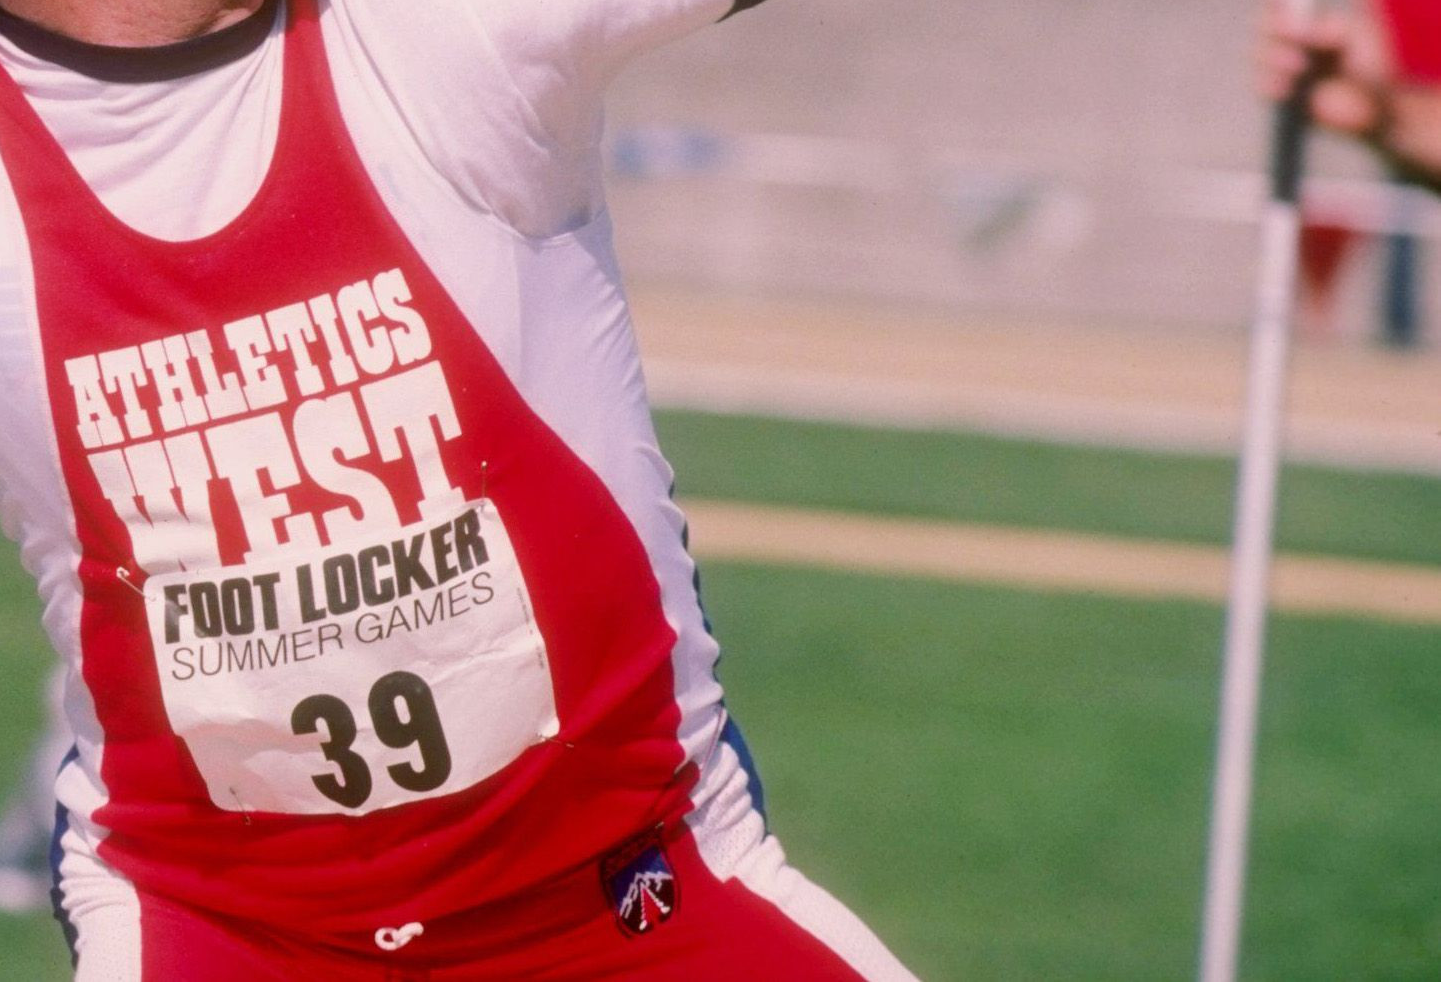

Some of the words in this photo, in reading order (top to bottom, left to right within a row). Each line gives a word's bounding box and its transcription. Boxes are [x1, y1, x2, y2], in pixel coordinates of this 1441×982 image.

[64, 267, 432, 449] ATHLETICS
[87, 360, 462, 575] WEST
[163, 571, 281, 644] FOOT
[296, 508, 490, 624] LOCKER
[171, 623, 344, 681] SUMMER
[355, 571, 495, 644] GAMES
[290, 671, 452, 809] 39
